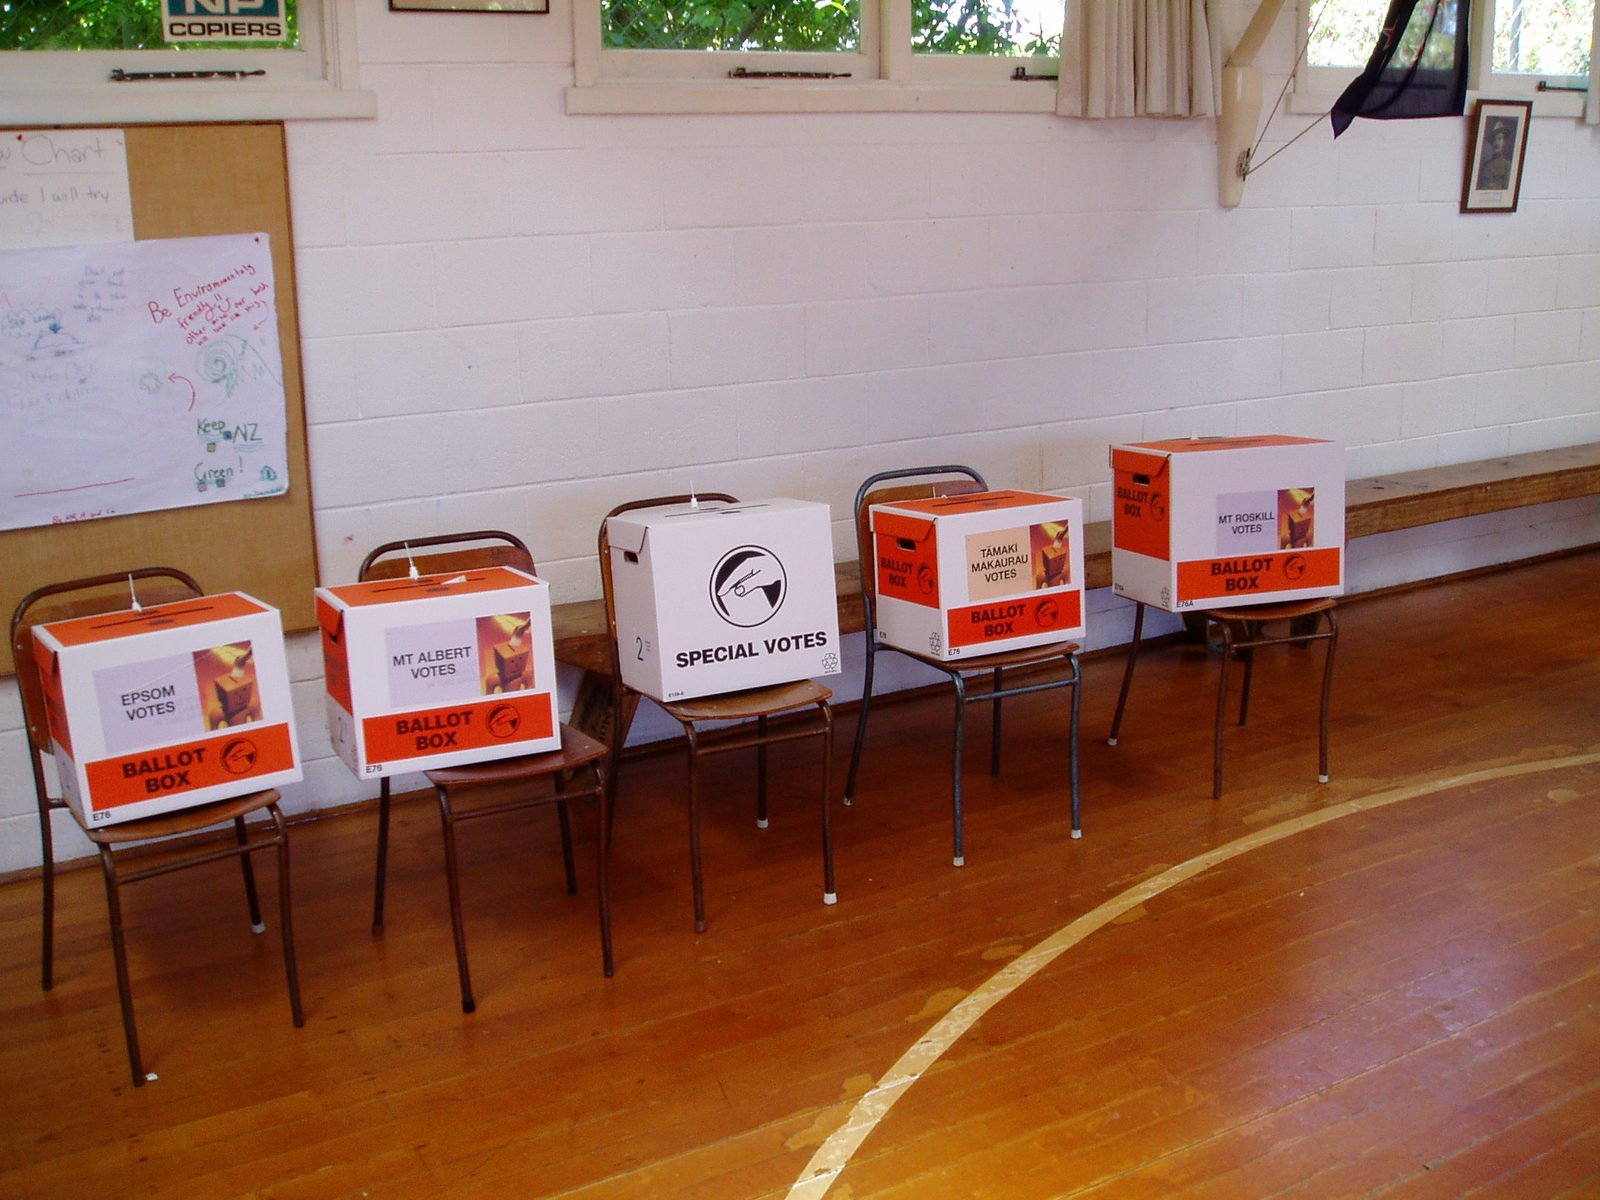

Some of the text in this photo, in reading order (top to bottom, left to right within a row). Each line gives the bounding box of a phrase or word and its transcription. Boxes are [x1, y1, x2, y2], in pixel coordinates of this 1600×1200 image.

[170, 22, 282, 36] COPIERS
[21, 134, 105, 165] Chart
[87, 185, 109, 204] try
[147, 301, 172, 324] Be
[197, 418, 262, 443] Keep NZ
[1118, 487, 1149, 503] BALLOT
[1124, 503, 1141, 517] BOX
[1218, 511, 1275, 525] MT ROSKILL
[1231, 523, 1262, 535] VOTES
[981, 543, 1018, 558] TĀMAKI
[881, 557, 913, 575] BALLOT
[971, 554, 1029, 573] MAKAURAU
[1211, 558, 1273, 576] BALLOT
[889, 573, 907, 588] BOX
[985, 568, 1017, 583] VOTES
[1225, 576, 1259, 592] BOX
[1176, 600, 1194, 608] E76A
[970, 603, 1027, 624] BALLOT
[984, 621, 1014, 638] BOX
[393, 646, 471, 667] MT ALBERT
[676, 642, 759, 668] SPECIAL
[764, 631, 828, 654] VOTES
[949, 648, 961, 656] E76
[411, 663, 456, 679] VOTES
[121, 685, 175, 706] EPSOM
[126, 701, 175, 721] VOTES
[396, 711, 474, 735] BALLOT
[415, 731, 457, 751] BOX
[122, 748, 206, 779] BALLOT
[366, 764, 383, 773] E76
[144, 769, 191, 794] BOX
[92, 810, 111, 822] E76
